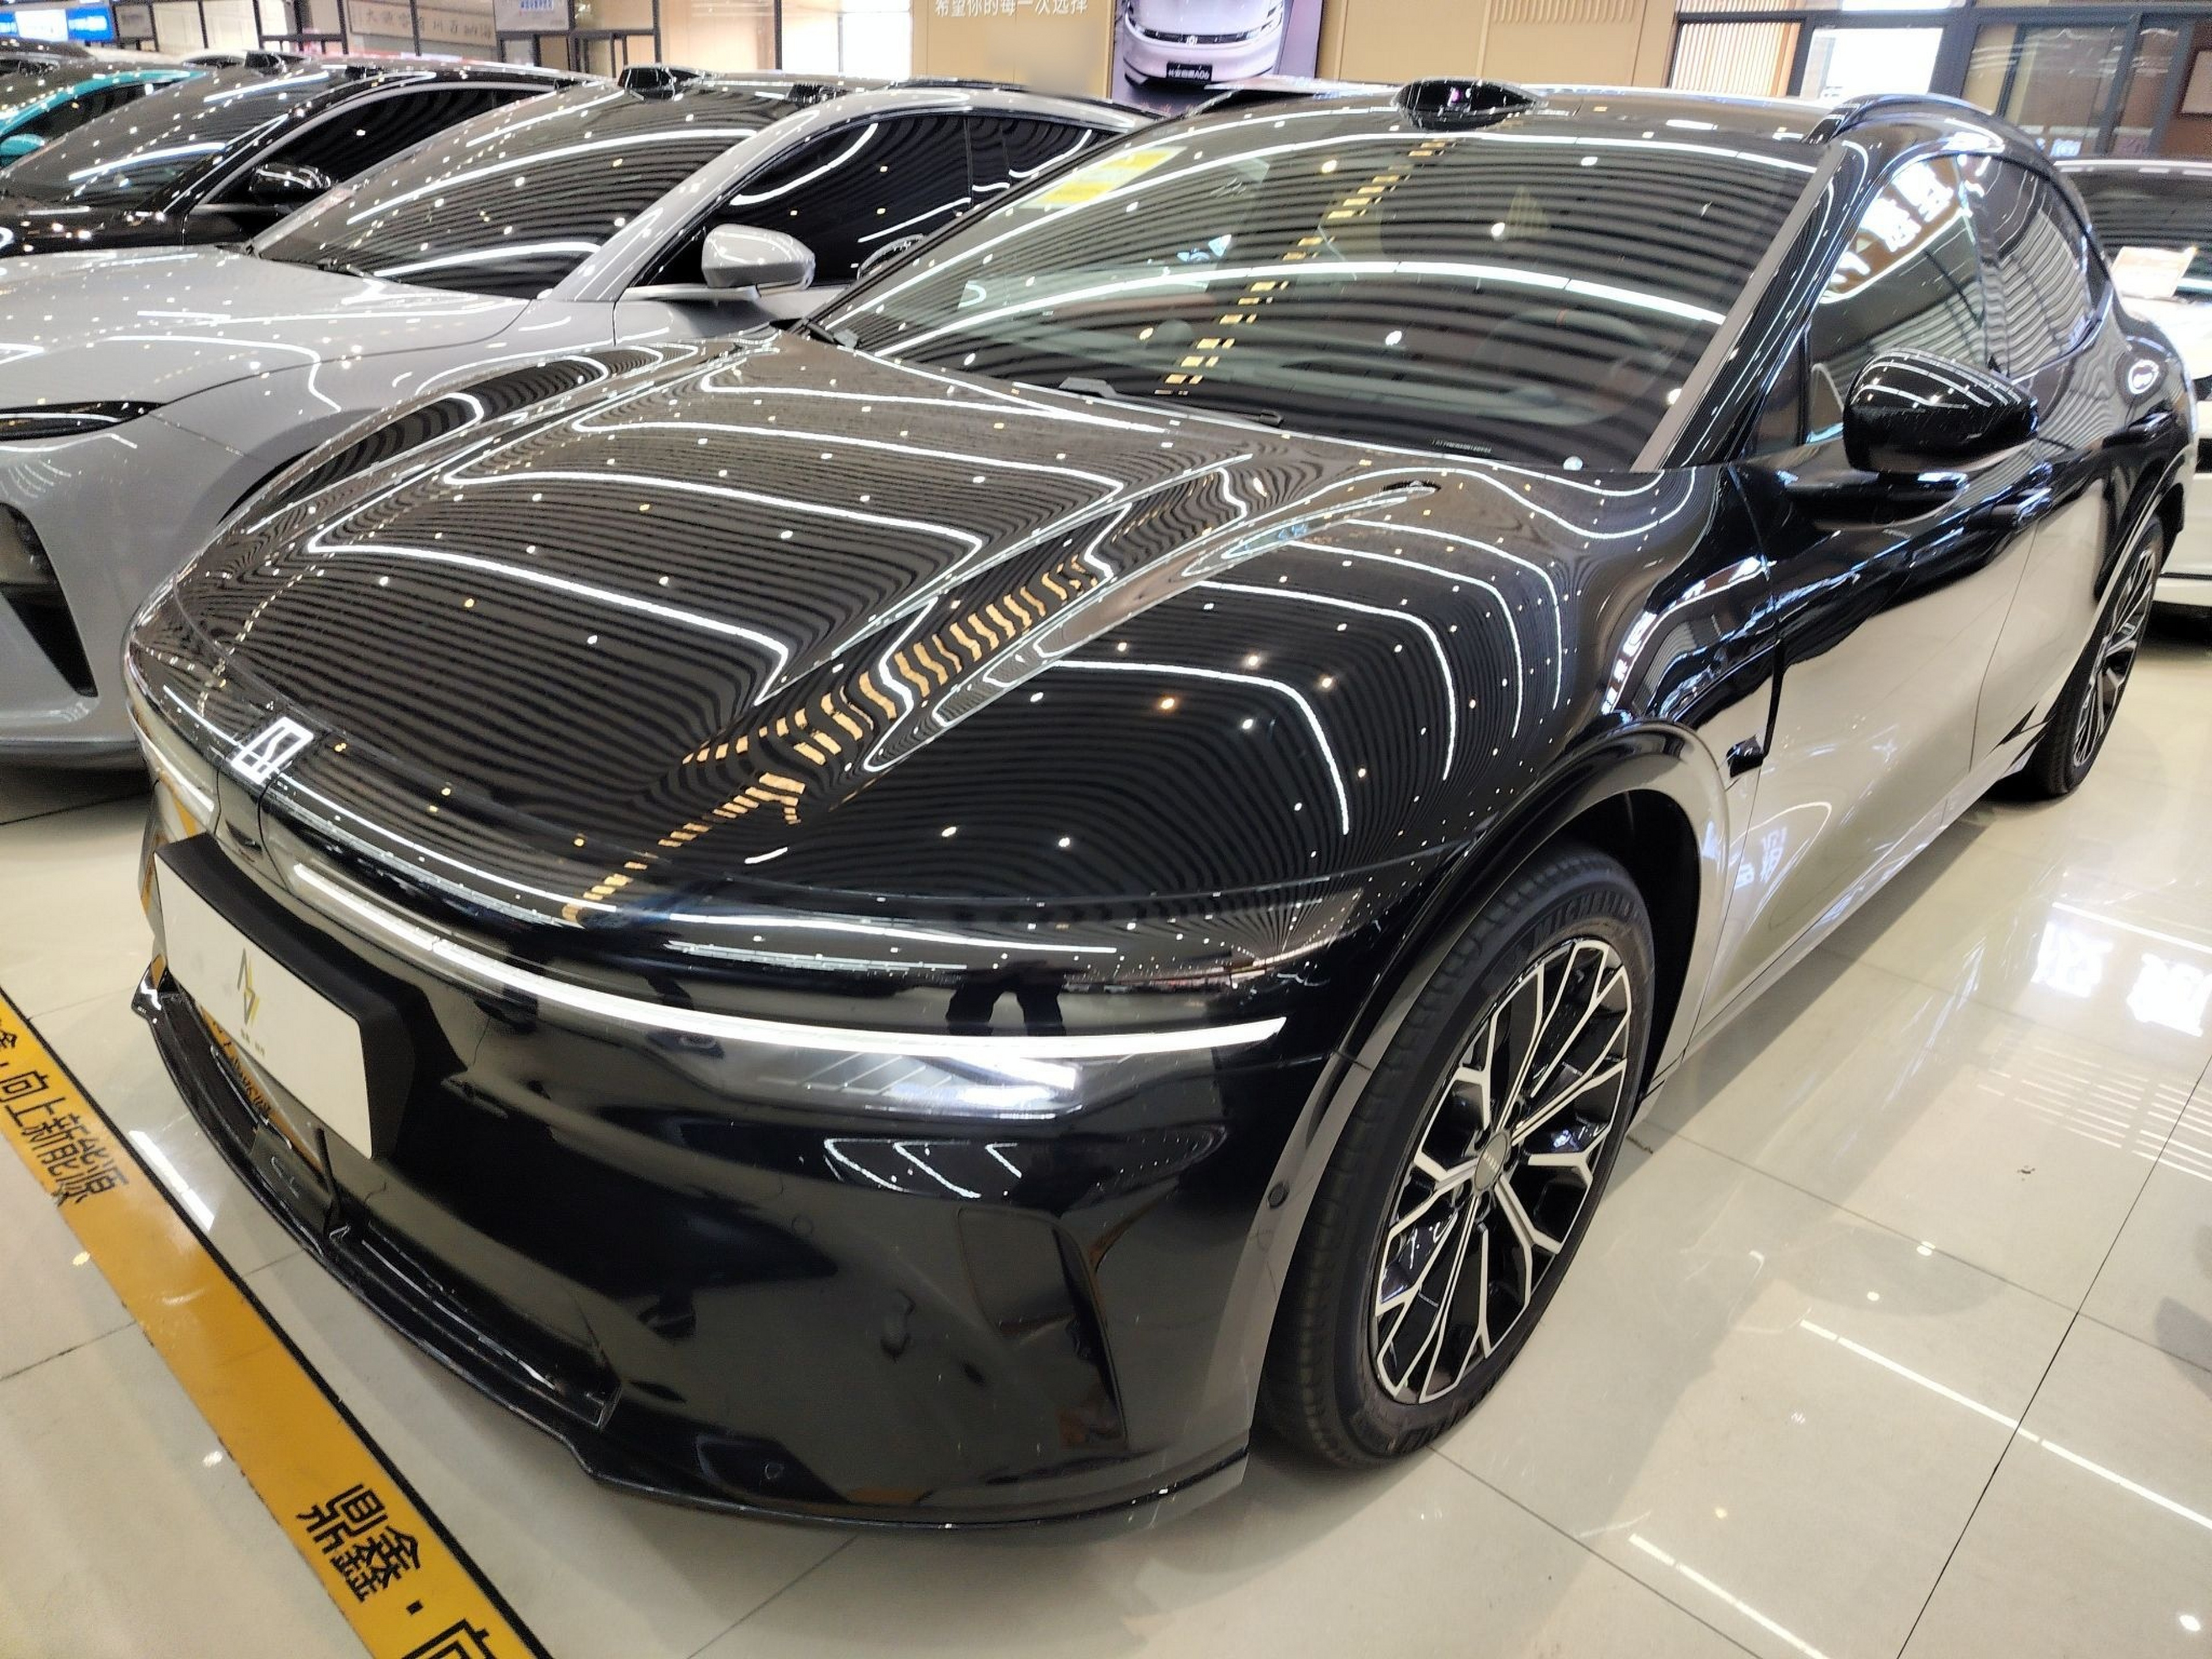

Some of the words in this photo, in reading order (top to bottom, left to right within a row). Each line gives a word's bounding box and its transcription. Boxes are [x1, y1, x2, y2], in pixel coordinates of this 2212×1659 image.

[935, 0, 1088, 17] 希望你的每一次选择
